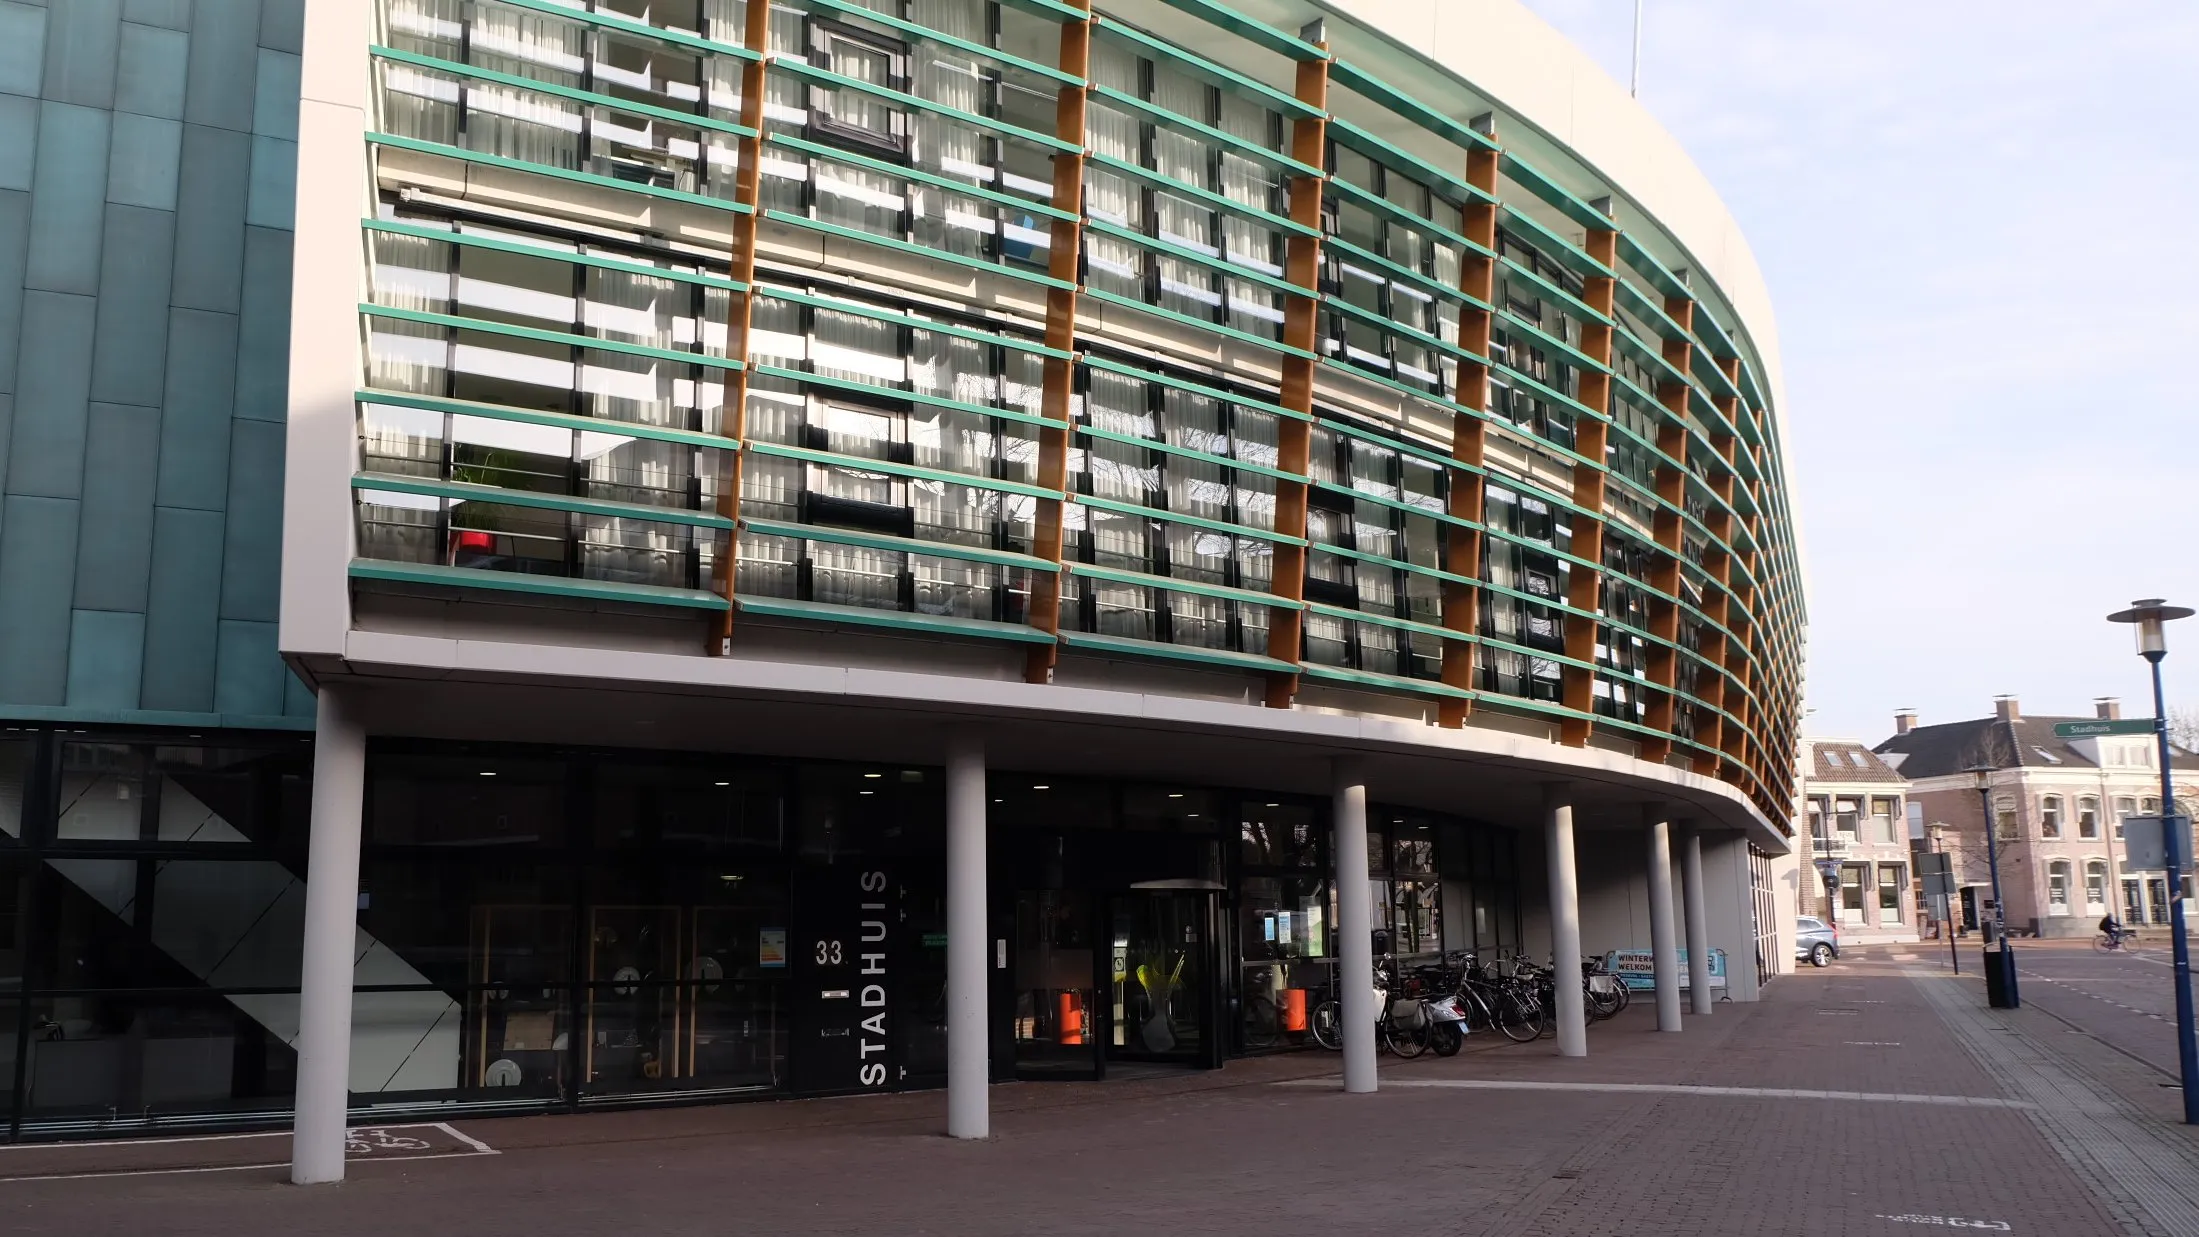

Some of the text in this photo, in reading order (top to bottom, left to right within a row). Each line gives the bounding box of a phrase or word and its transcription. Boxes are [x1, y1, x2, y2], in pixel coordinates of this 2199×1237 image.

[2069, 725, 2111, 734] Stadhuis
[815, 940, 842, 964] 33
[1618, 963, 1652, 971] WELKOM
[860, 871, 887, 1085] STADHUIS
